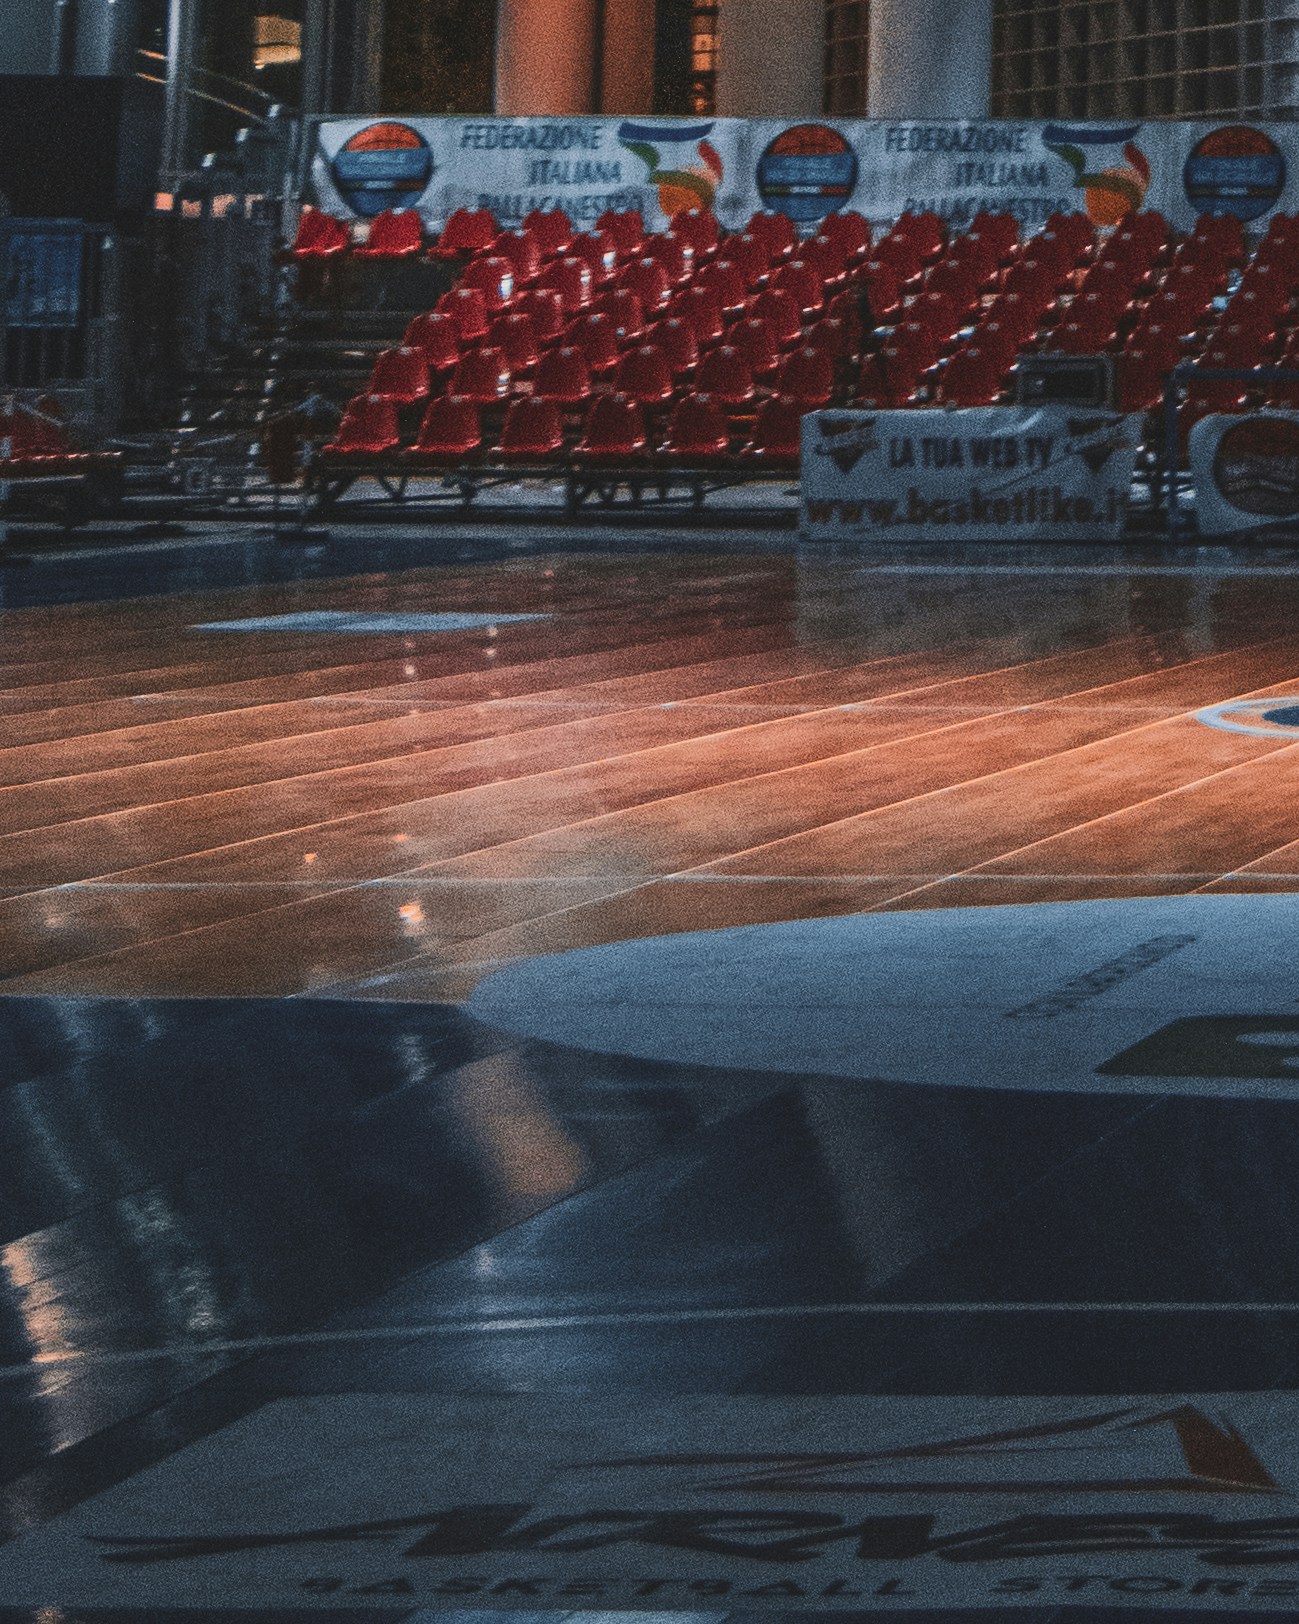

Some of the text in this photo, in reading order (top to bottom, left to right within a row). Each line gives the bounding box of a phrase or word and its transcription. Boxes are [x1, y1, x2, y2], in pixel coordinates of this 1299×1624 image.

[460, 124, 602, 149] FEDERAZIONE
[885, 128, 1027, 153] FEDERAZIONE
[528, 159, 622, 185] ITALIANA
[955, 162, 1049, 188] ITALIANA
[890, 438, 914, 468] LA
[921, 438, 964, 468] TUA
[970, 438, 1018, 468] WEB
[1026, 437, 1054, 468] TV
[298, 1577, 918, 1598] BASKETBALL
